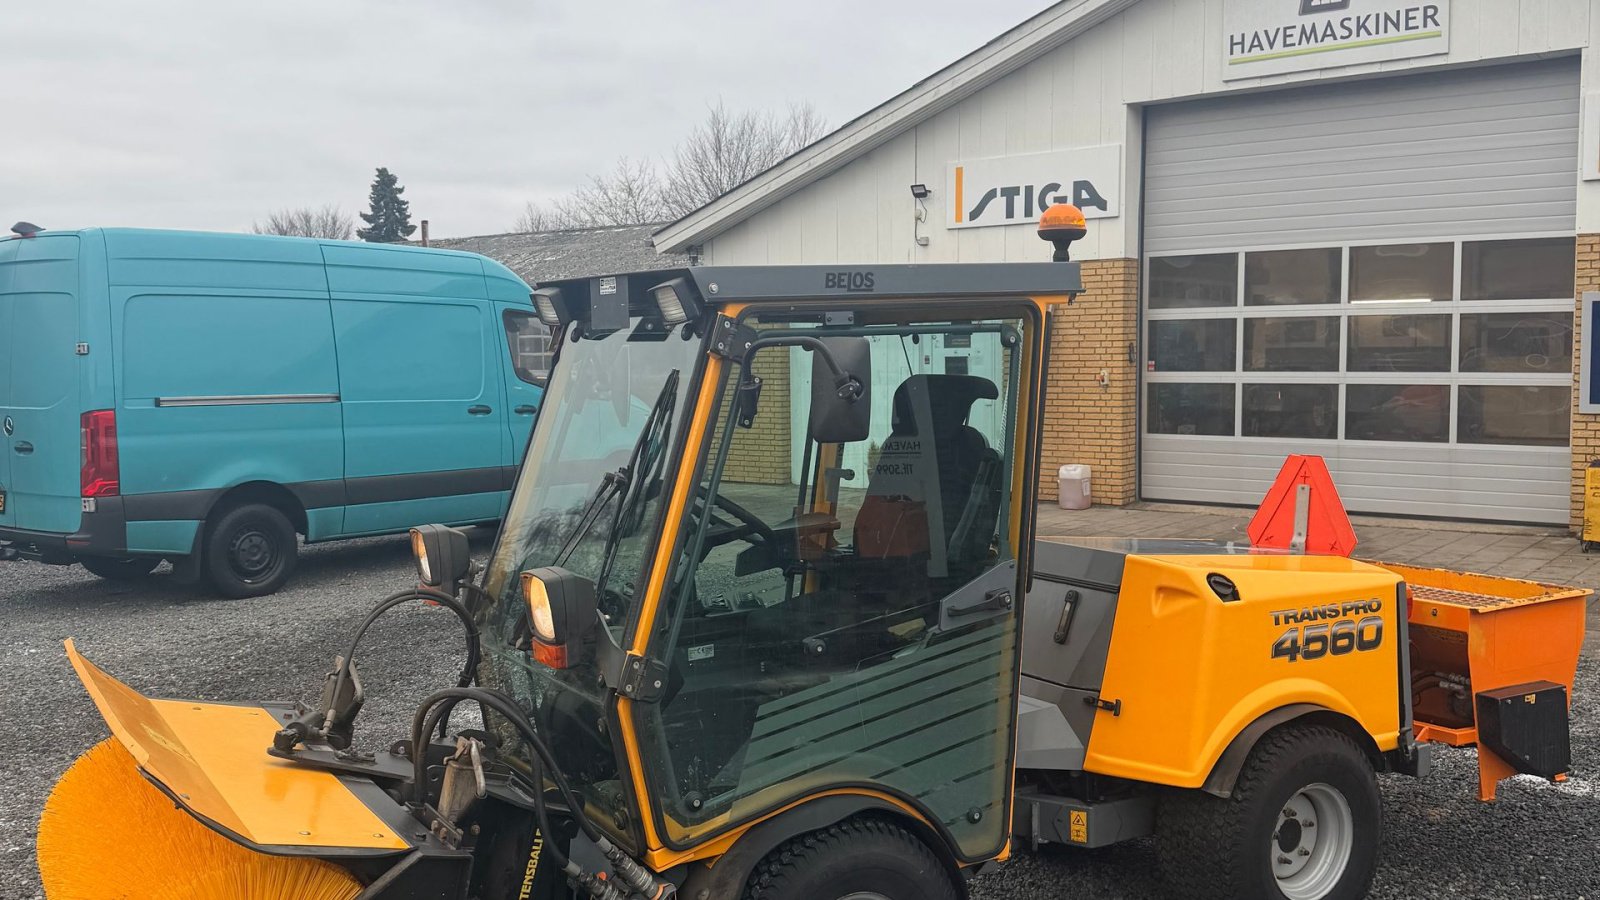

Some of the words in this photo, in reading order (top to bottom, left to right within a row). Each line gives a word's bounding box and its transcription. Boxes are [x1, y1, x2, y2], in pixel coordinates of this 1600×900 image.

[1229, 5, 1440, 55] HAVEMASKINER
[969, 180, 1108, 221] STIGA
[825, 271, 875, 292] BELOS
[1270, 603, 1340, 626] TRANS
[1342, 598, 1382, 617] PRO
[1271, 616, 1383, 662] 4560
